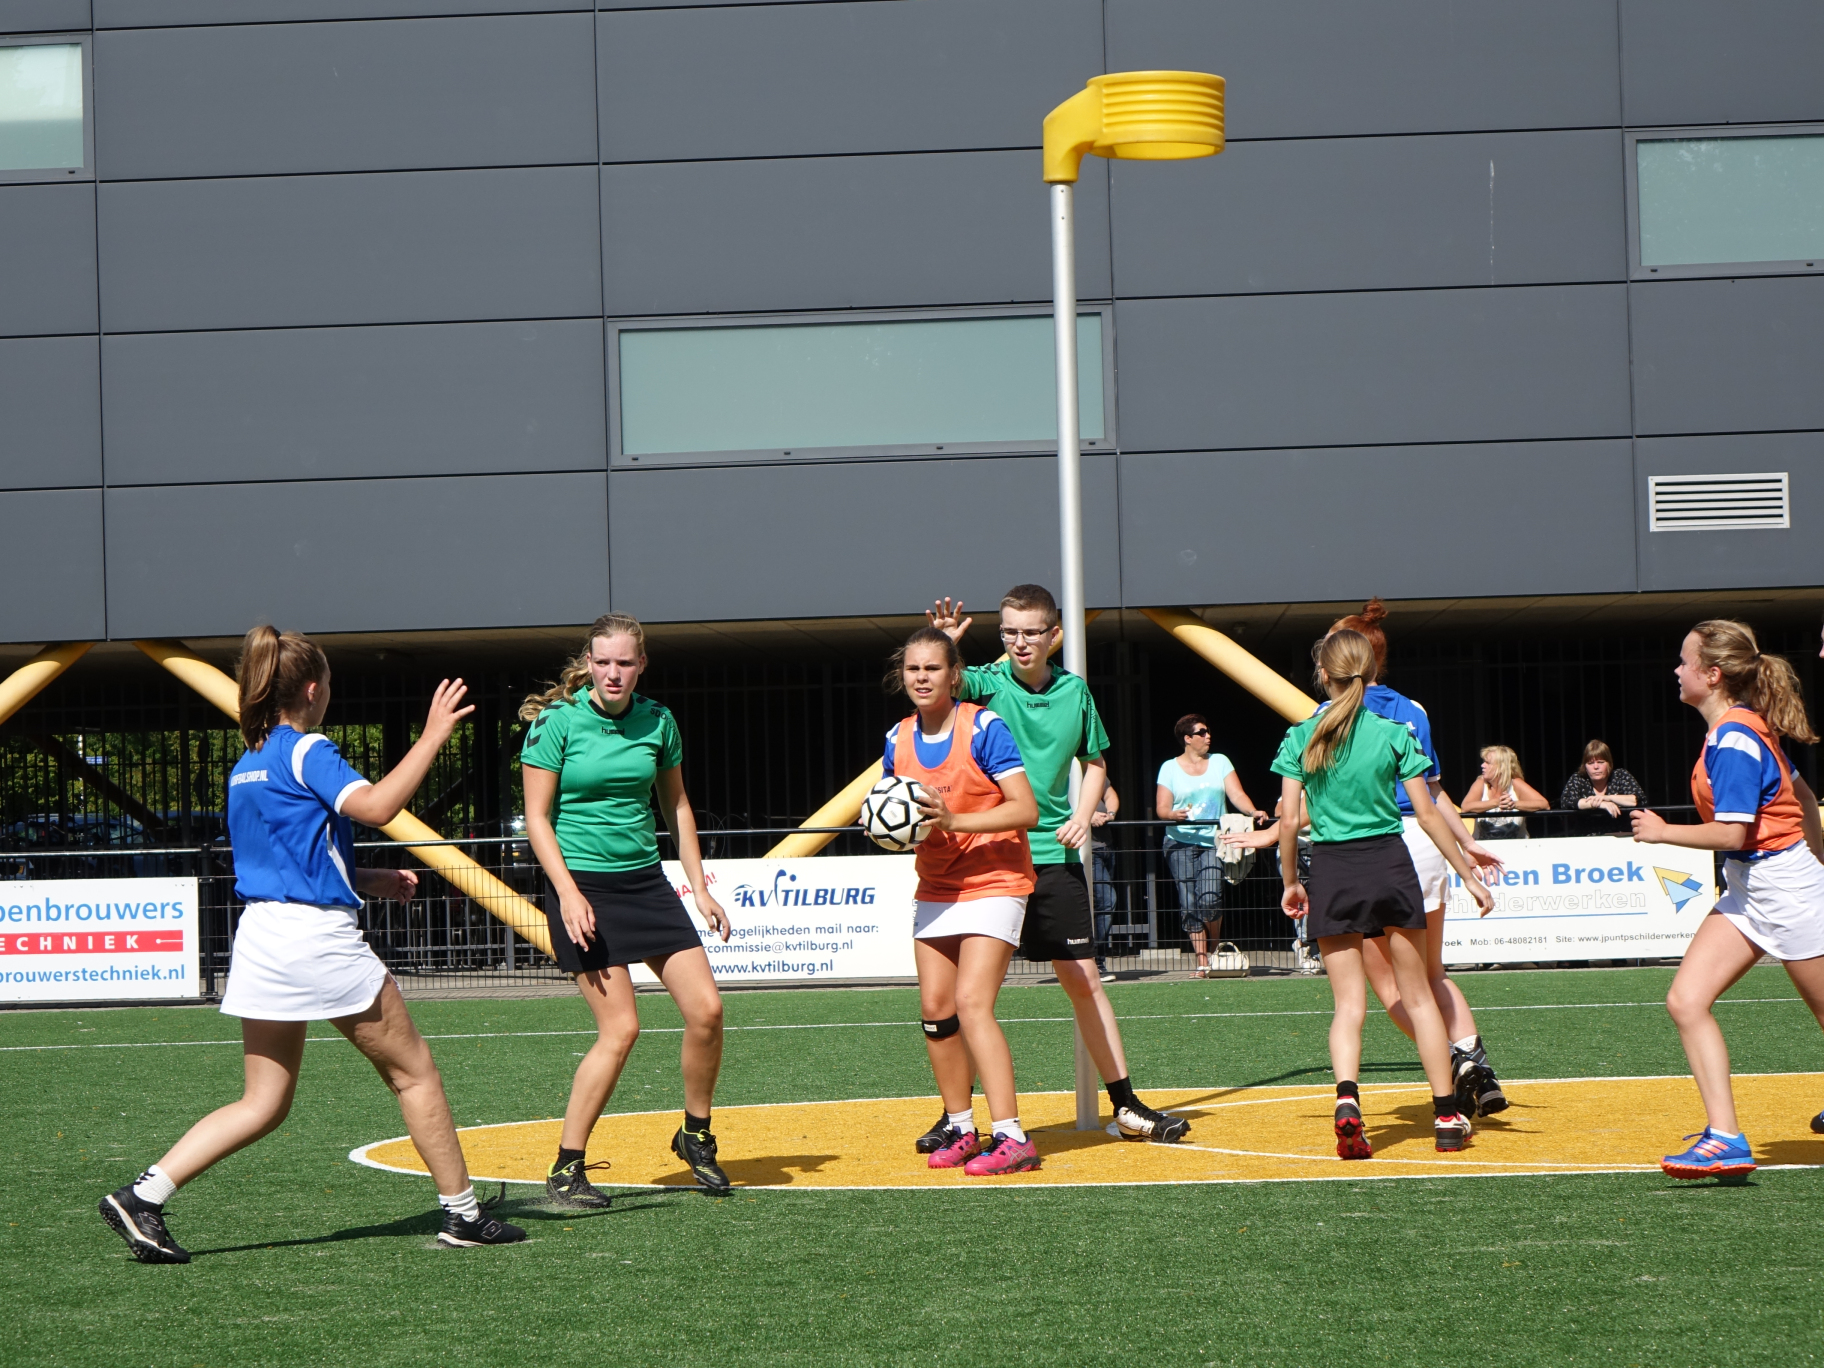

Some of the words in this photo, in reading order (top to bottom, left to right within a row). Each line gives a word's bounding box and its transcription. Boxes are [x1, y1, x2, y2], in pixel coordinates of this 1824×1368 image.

[1552, 861, 1645, 884] Broek
[720, 924, 811, 939] ogelijkheden
[815, 923, 842, 934] mail
[846, 925, 879, 933] naar:
[1470, 938, 1492, 946] Mob:
[1494, 936, 1548, 945] 06-48082181
[1555, 935, 1576, 943] Site:
[711, 959, 833, 975] www.kvtilburg.nl
